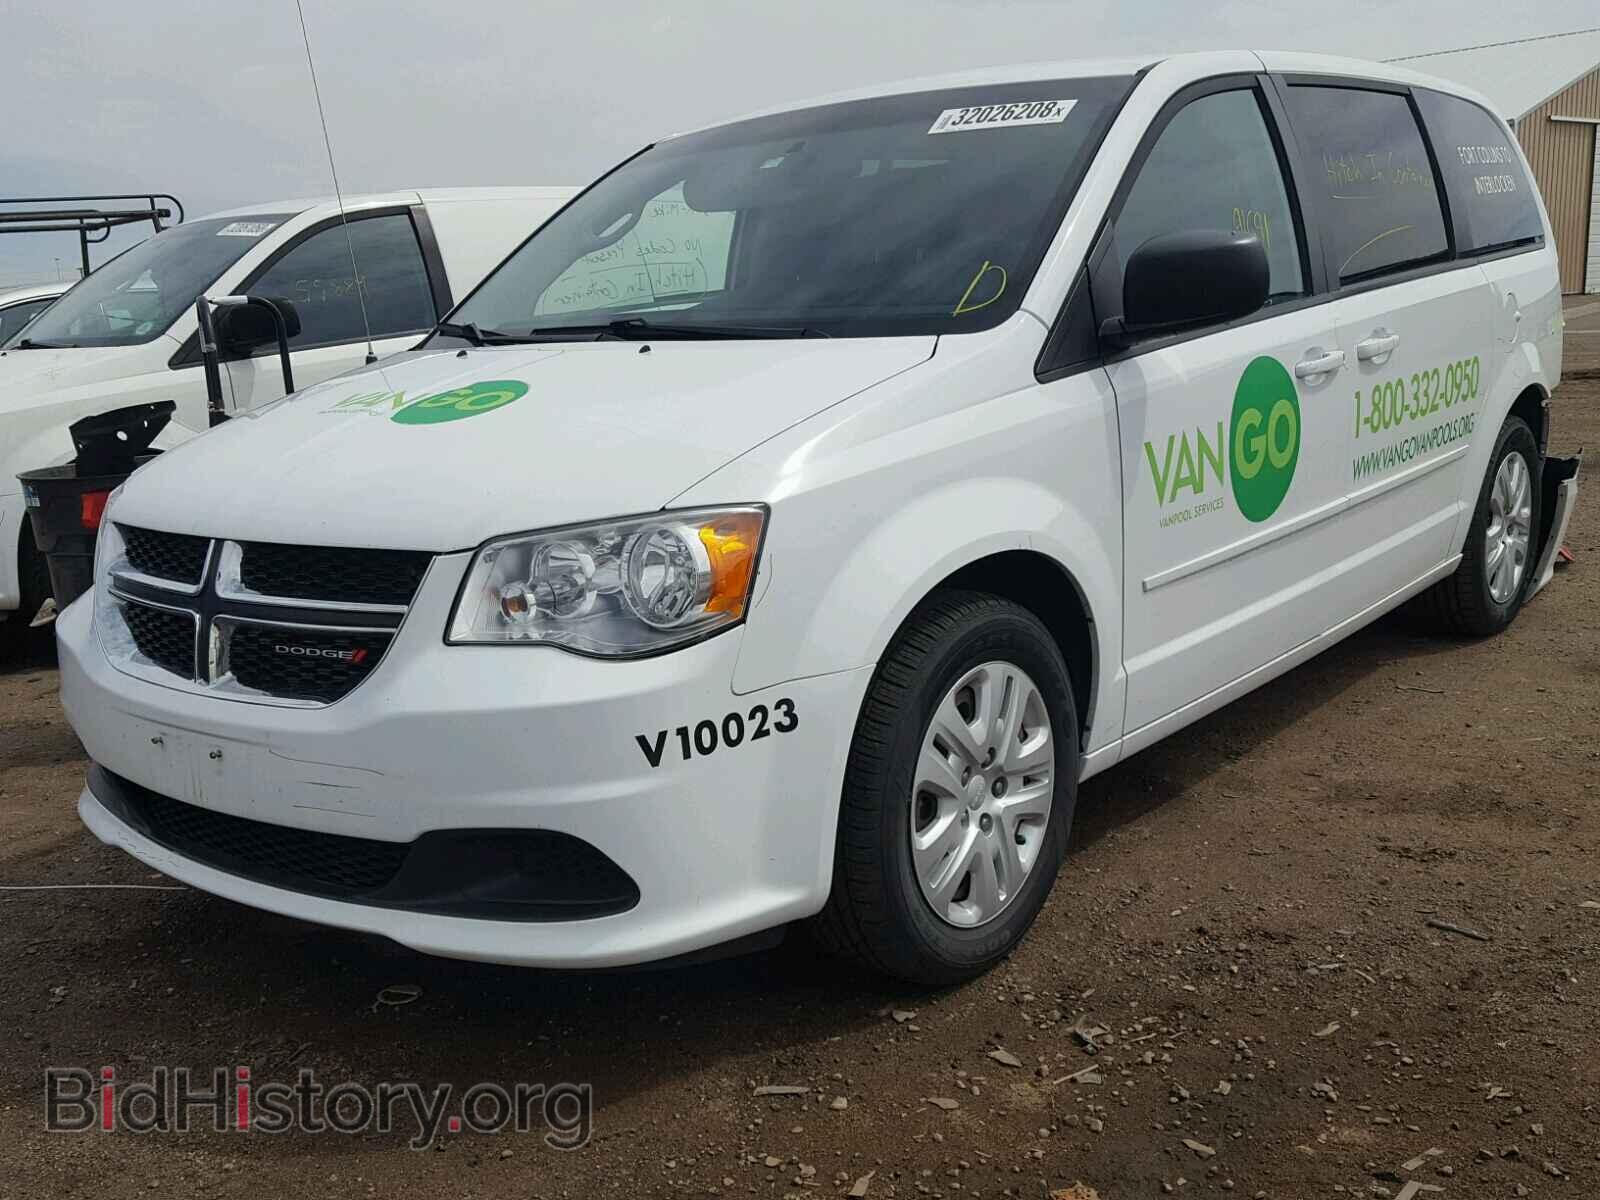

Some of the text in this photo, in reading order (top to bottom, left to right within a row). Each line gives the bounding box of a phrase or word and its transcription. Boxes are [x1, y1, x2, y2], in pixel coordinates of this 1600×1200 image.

[1474, 175, 1520, 194] INTERLOCKEN
[951, 261, 1007, 317] D
[1355, 356, 1480, 439] 1-800-332-0950
[1353, 412, 1475, 482] WWW.VANGOVANPOOLS.ORG
[1159, 497, 1224, 528] VANPOOL SERVICES
[274, 645, 353, 660] DODGE
